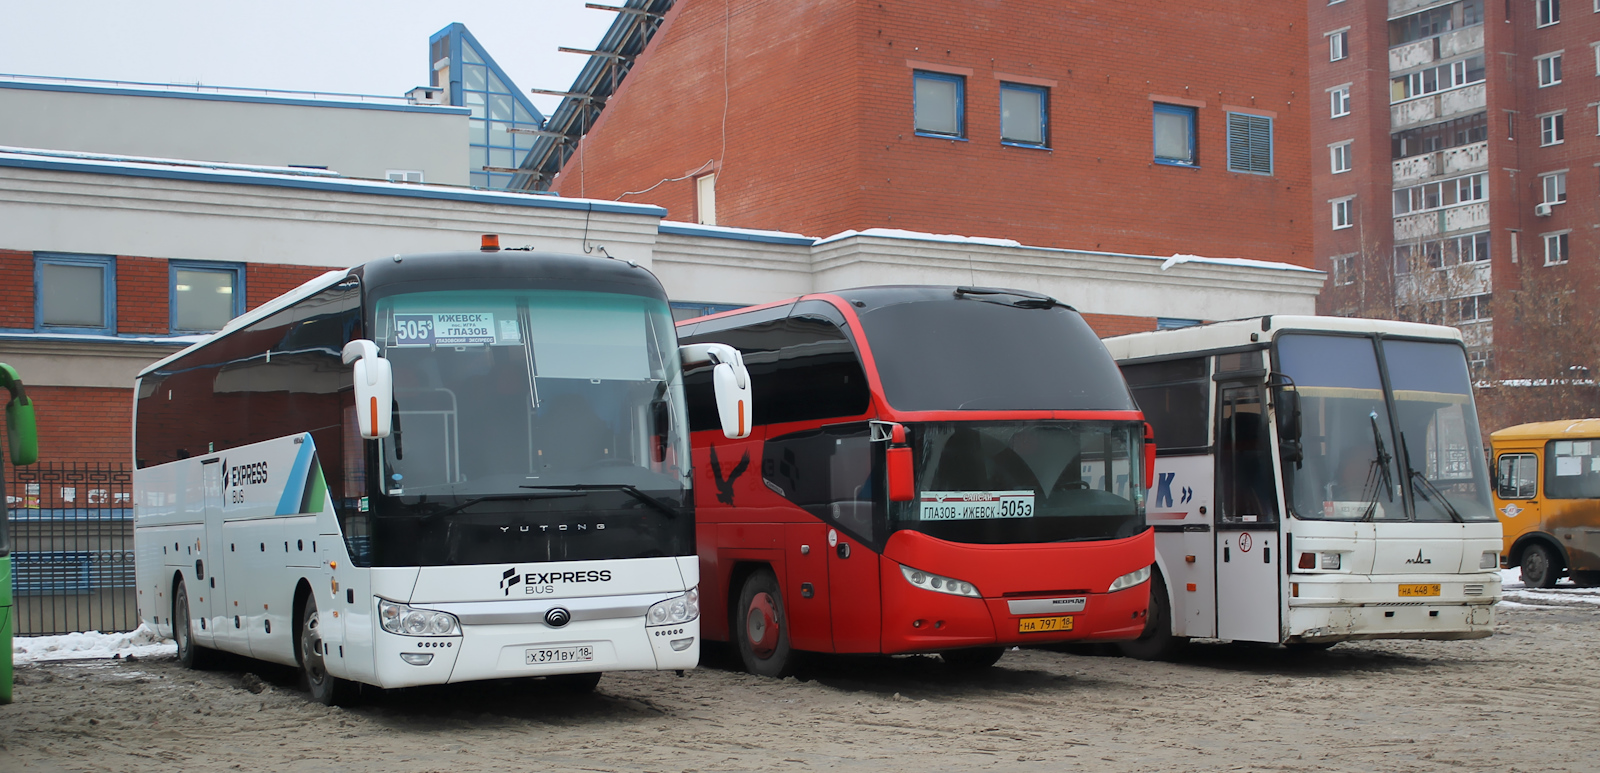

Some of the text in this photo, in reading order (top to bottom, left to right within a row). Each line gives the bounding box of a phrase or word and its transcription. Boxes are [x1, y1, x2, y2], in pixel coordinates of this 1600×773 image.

[438, 314, 482, 322] ИЖЕВСК
[447, 328, 488, 336] ГЛАЗОВ
[232, 461, 267, 487] EXPRESS
[232, 489, 244, 504] BUS
[962, 493, 992, 501] САПСАН
[924, 507, 956, 519] ГЛАЗОВ
[962, 506, 996, 518] ИЖЕВСК
[500, 523, 605, 533] YUTONG
[525, 570, 612, 585] EXPRESS
[525, 585, 554, 594] BUS
[1414, 586, 1427, 595] 448
[1024, 622, 1035, 630] НА
[1040, 618, 1057, 629] 797
[579, 647, 589, 656] 18
